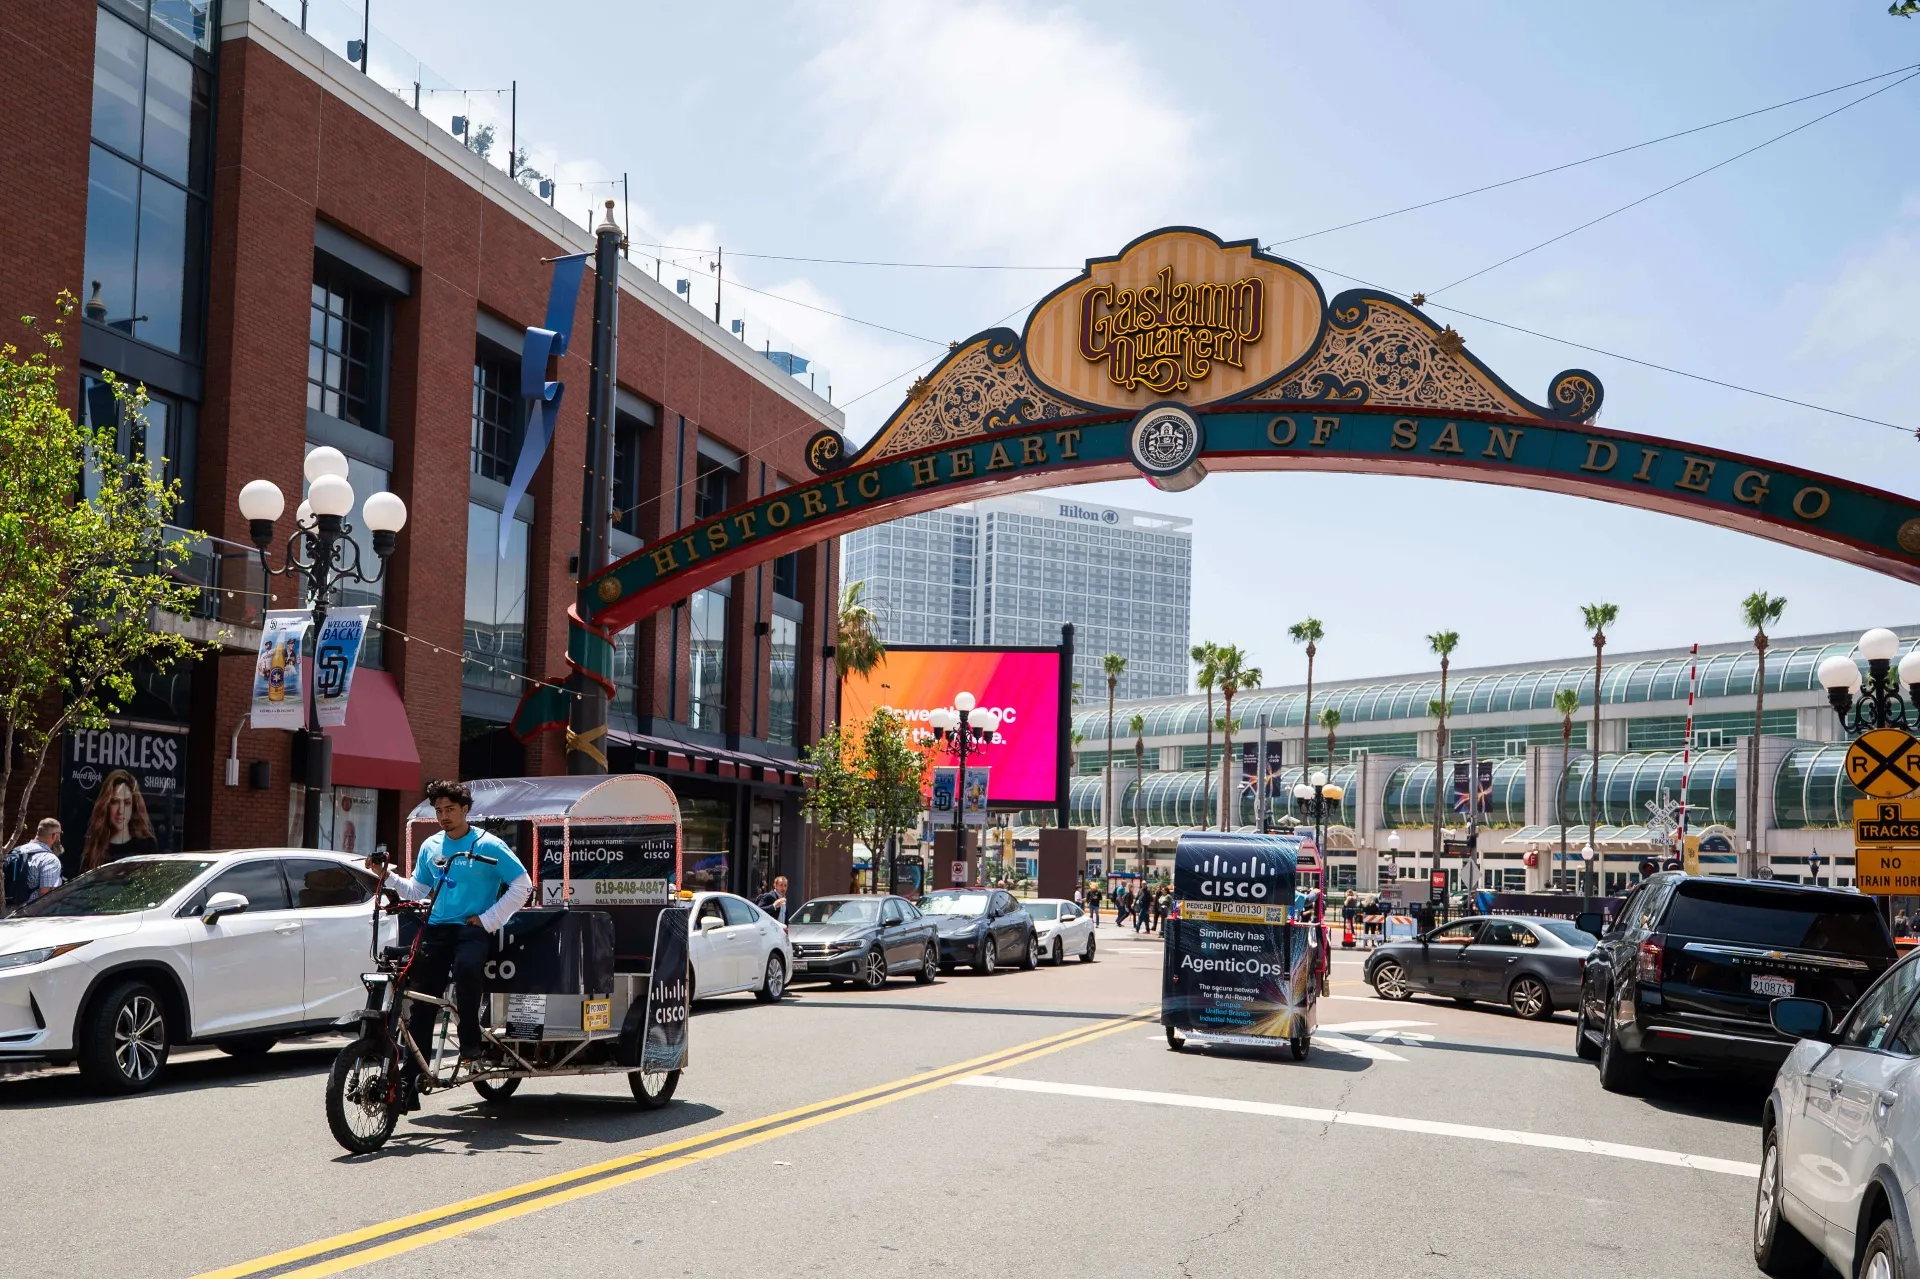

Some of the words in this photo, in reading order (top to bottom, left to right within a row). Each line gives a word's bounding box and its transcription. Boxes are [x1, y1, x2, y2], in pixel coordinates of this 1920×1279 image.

[1079, 265, 1264, 367] Gaslamp
[649, 470, 881, 577] HISTORIC
[910, 430, 1083, 487] HEART
[1266, 416, 1340, 446] OF
[1391, 419, 1524, 460] SAN
[1580, 439, 1831, 520] DIEGO
[1059, 504, 1099, 521] Hilton
[327, 620, 362, 628] WELCOME
[322, 628, 360, 640] BACK!
[74, 728, 178, 771] FEARLESS
[1852, 756, 1868, 772] R
[1906, 755, 1920, 771] R
[144, 776, 176, 789] SHAKIRA
[1884, 806, 1894, 820] 3
[1663, 816, 1678, 830] ROAD
[1862, 825, 1919, 837] TRACKS
[544, 848, 624, 864] AgnticOps
[644, 851, 670, 859] CISCO
[1880, 858, 1902, 869] NO
[595, 880, 666, 894] 619-648-4847
[1860, 875, 1890, 887] TRAIN
[1200, 880, 1267, 898] CISCO
[1222, 904, 1233, 912] PC
[1236, 905, 1262, 914] 00130
[1199, 928, 1245, 940] Simplicity
[1248, 932, 1265, 941] has
[1210, 942, 1230, 950] new
[1232, 943, 1261, 952] name:
[1181, 954, 1281, 977] AgenticOps
[1753, 980, 1793, 994] 91087S3
[1225, 994, 1254, 1002] AI-Ready
[656, 1005, 684, 1024] CISCO
